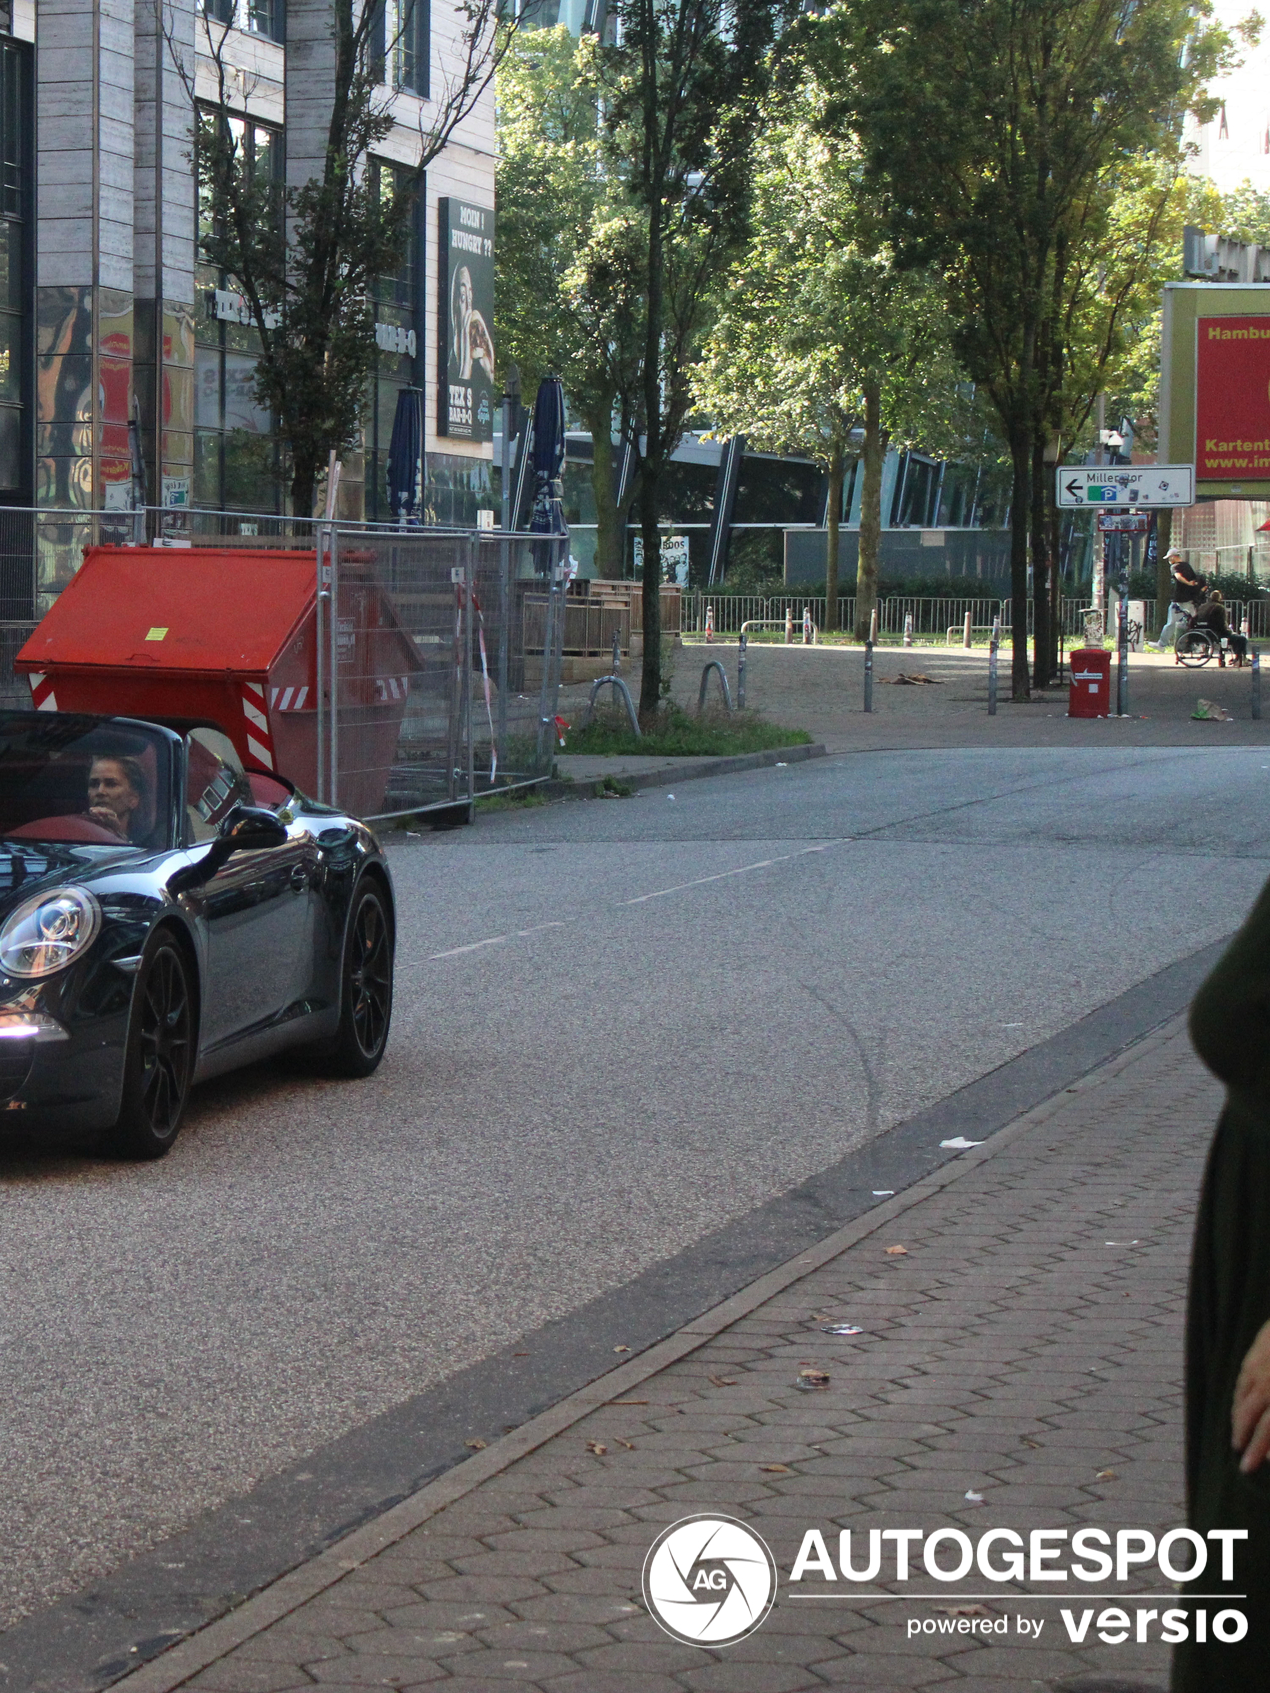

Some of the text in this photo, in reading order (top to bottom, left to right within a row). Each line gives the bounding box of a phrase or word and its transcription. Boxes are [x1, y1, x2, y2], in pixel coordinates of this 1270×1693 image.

[460, 205, 480, 230] MOIN
[451, 228, 492, 258] HUNGRY ??
[1208, 326, 1270, 340] Hambu
[448, 406, 473, 425] BAR-B-Q
[1086, 472, 1143, 484] Millertor
